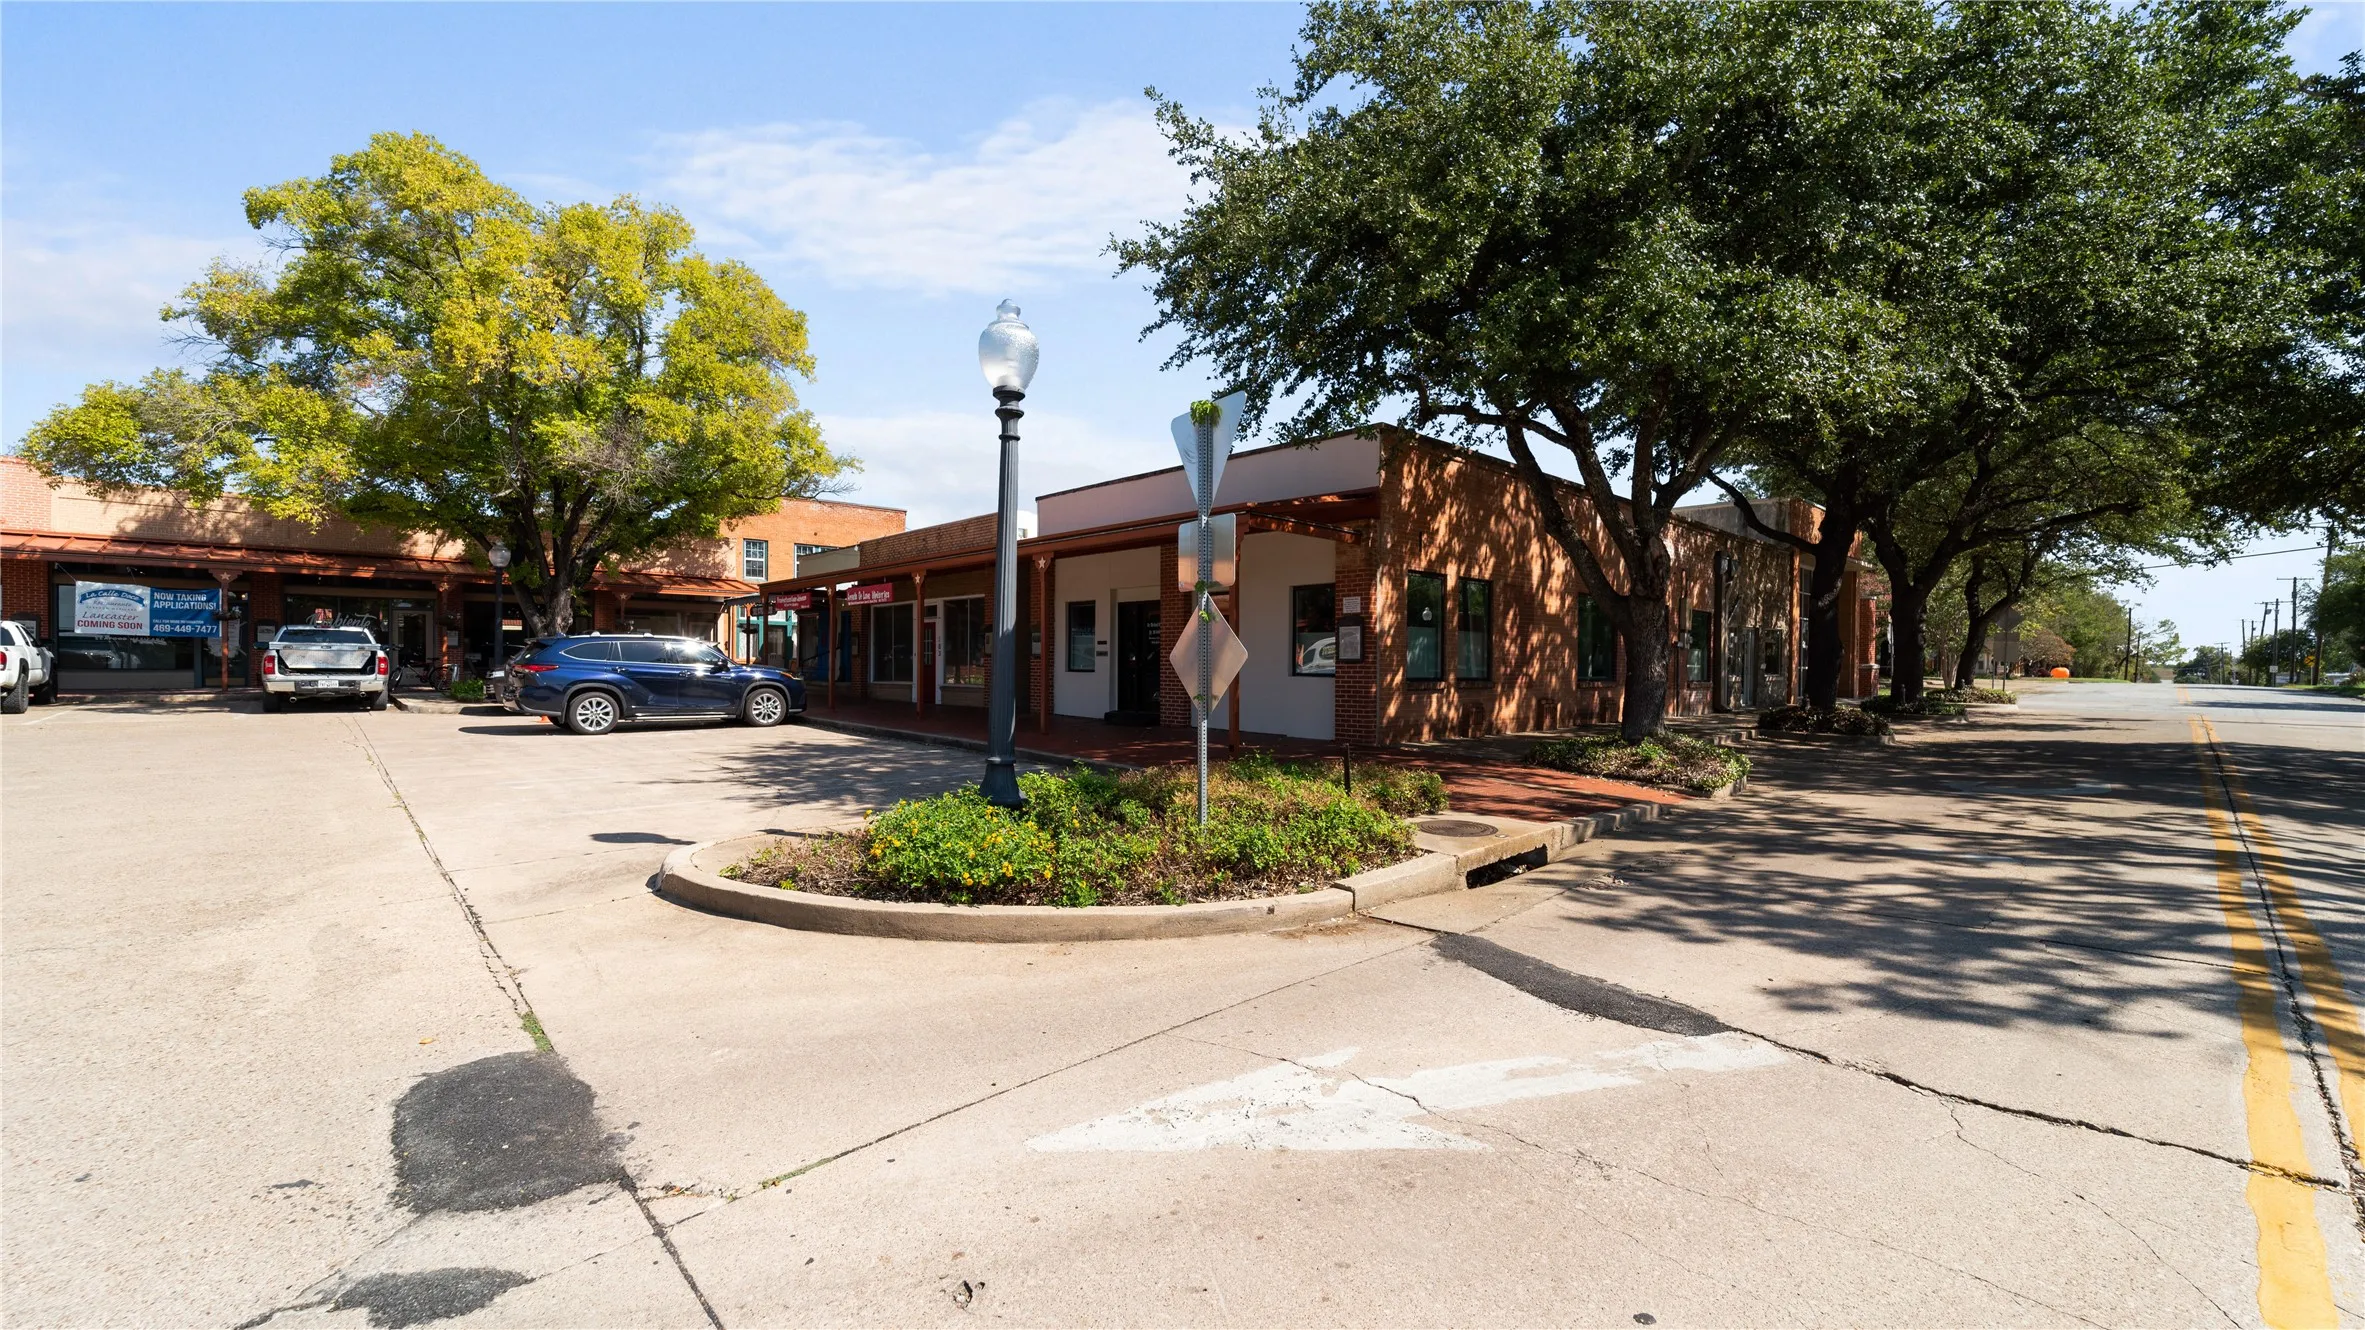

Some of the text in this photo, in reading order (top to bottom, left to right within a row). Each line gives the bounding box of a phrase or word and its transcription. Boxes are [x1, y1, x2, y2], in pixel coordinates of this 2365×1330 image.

[121, 592, 140, 600] Doce
[153, 592, 207, 601] NOW TAKING
[153, 600, 217, 610] APPLICATIONS!
[82, 611, 139, 621] Lancaster
[77, 620, 143, 630] COMING SOON
[153, 624, 217, 633] 469-449-7477
